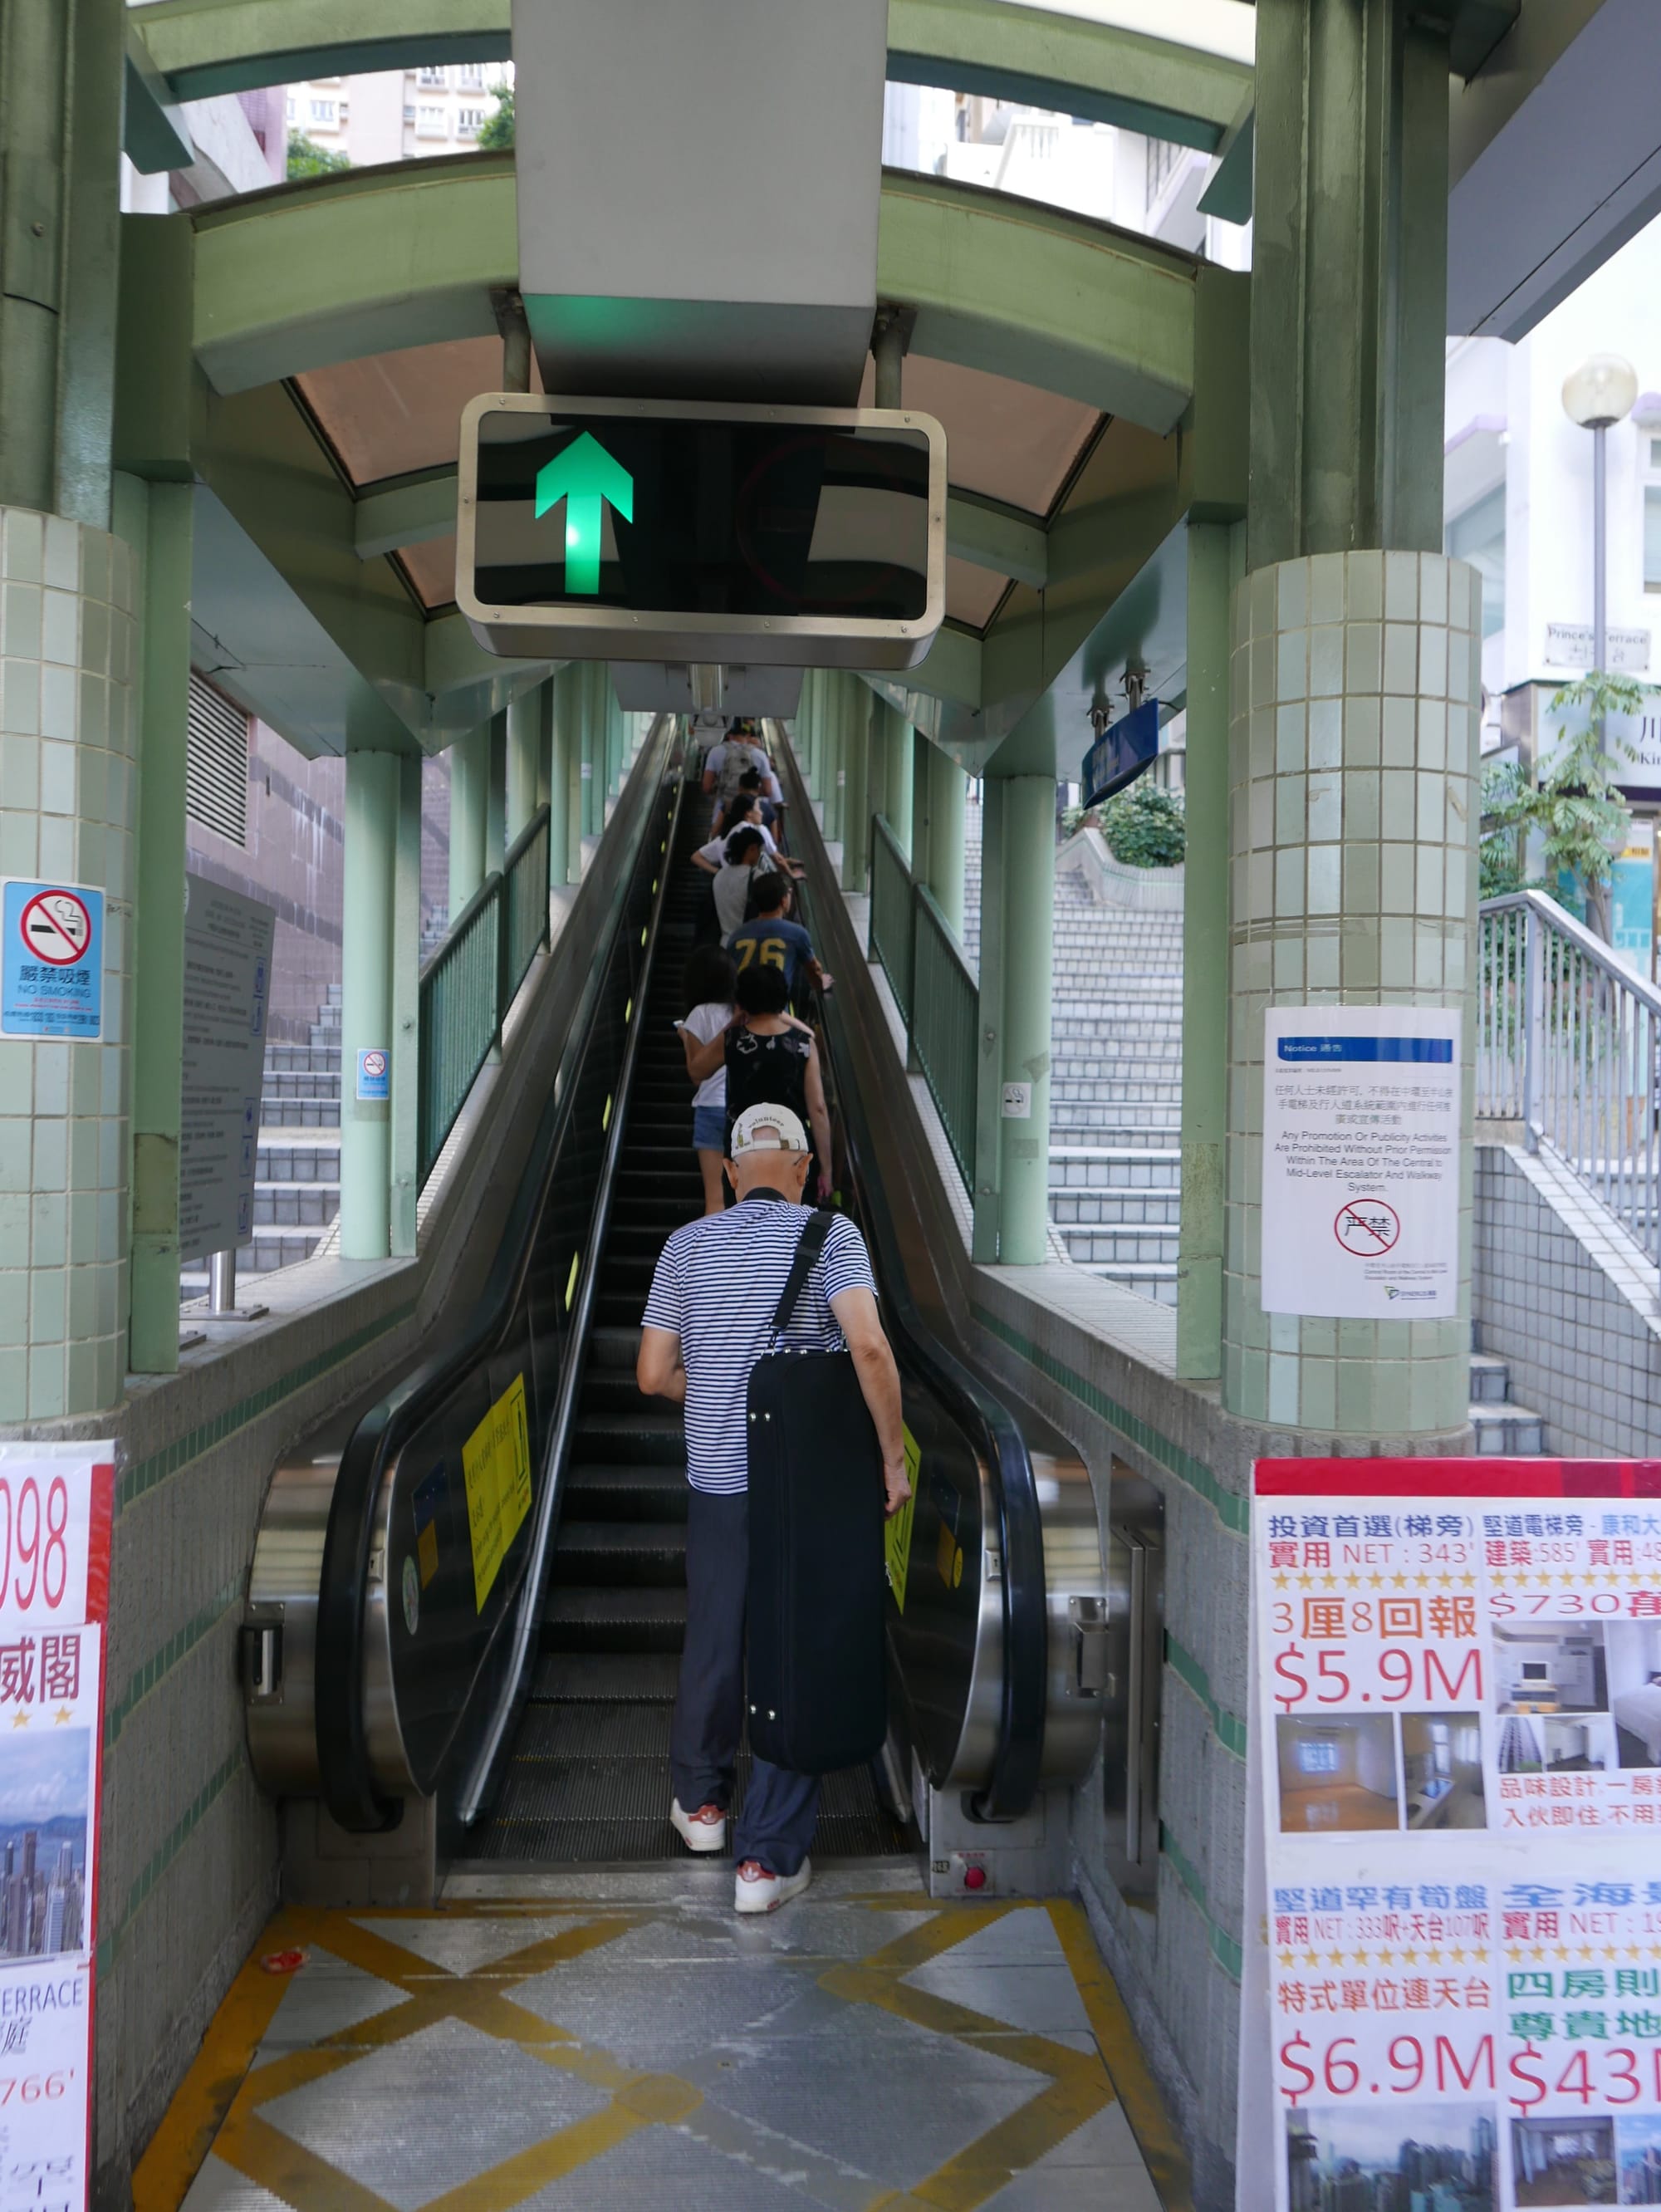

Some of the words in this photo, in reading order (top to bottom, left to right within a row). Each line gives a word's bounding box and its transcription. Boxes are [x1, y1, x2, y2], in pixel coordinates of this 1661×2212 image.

[1606, 634, 1648, 645] errace
[734, 937, 786, 975] 76
[17, 983, 37, 995] NO
[40, 985, 91, 998] SMOKING
[1283, 1044, 1317, 1053] Notice
[1281, 1131, 1299, 1141] Any
[1301, 1131, 1352, 1140] Promotion
[1355, 1131, 1369, 1141] Or
[1371, 1132, 1410, 1144] Publicity
[1275, 1143, 1290, 1152] Are
[1292, 1143, 1341, 1153] Prohibited
[1344, 1145, 1383, 1155] Without
[1385, 1145, 1408, 1155] Prior
[1286, 1155, 1316, 1165] Within
[1319, 1156, 1338, 1166] The
[1340, 1157, 1365, 1167] Area
[1367, 1157, 1379, 1167] Of
[1382, 1157, 1400, 1167] The
[1402, 1158, 1433, 1168] Central
[1286, 1168, 1333, 1178] Mid-Level
[1335, 1170, 1383, 1180] Escalator
[1385, 1170, 1404, 1180] And
[1406, 1170, 1443, 1183] Walkway
[1347, 1182, 1389, 1193] System.
[1268, 1540, 1332, 1569] 實用
[1343, 1543, 1394, 1565] NET
[1273, 1642, 1484, 1714] $5.9M
[1275, 1915, 1310, 1945] 實用
[1314, 1916, 1343, 1940] NET
[1502, 1911, 1559, 1940] 實用
[1569, 1912, 1619, 1935] NET
[1279, 2030, 1497, 2107] $6.9M
